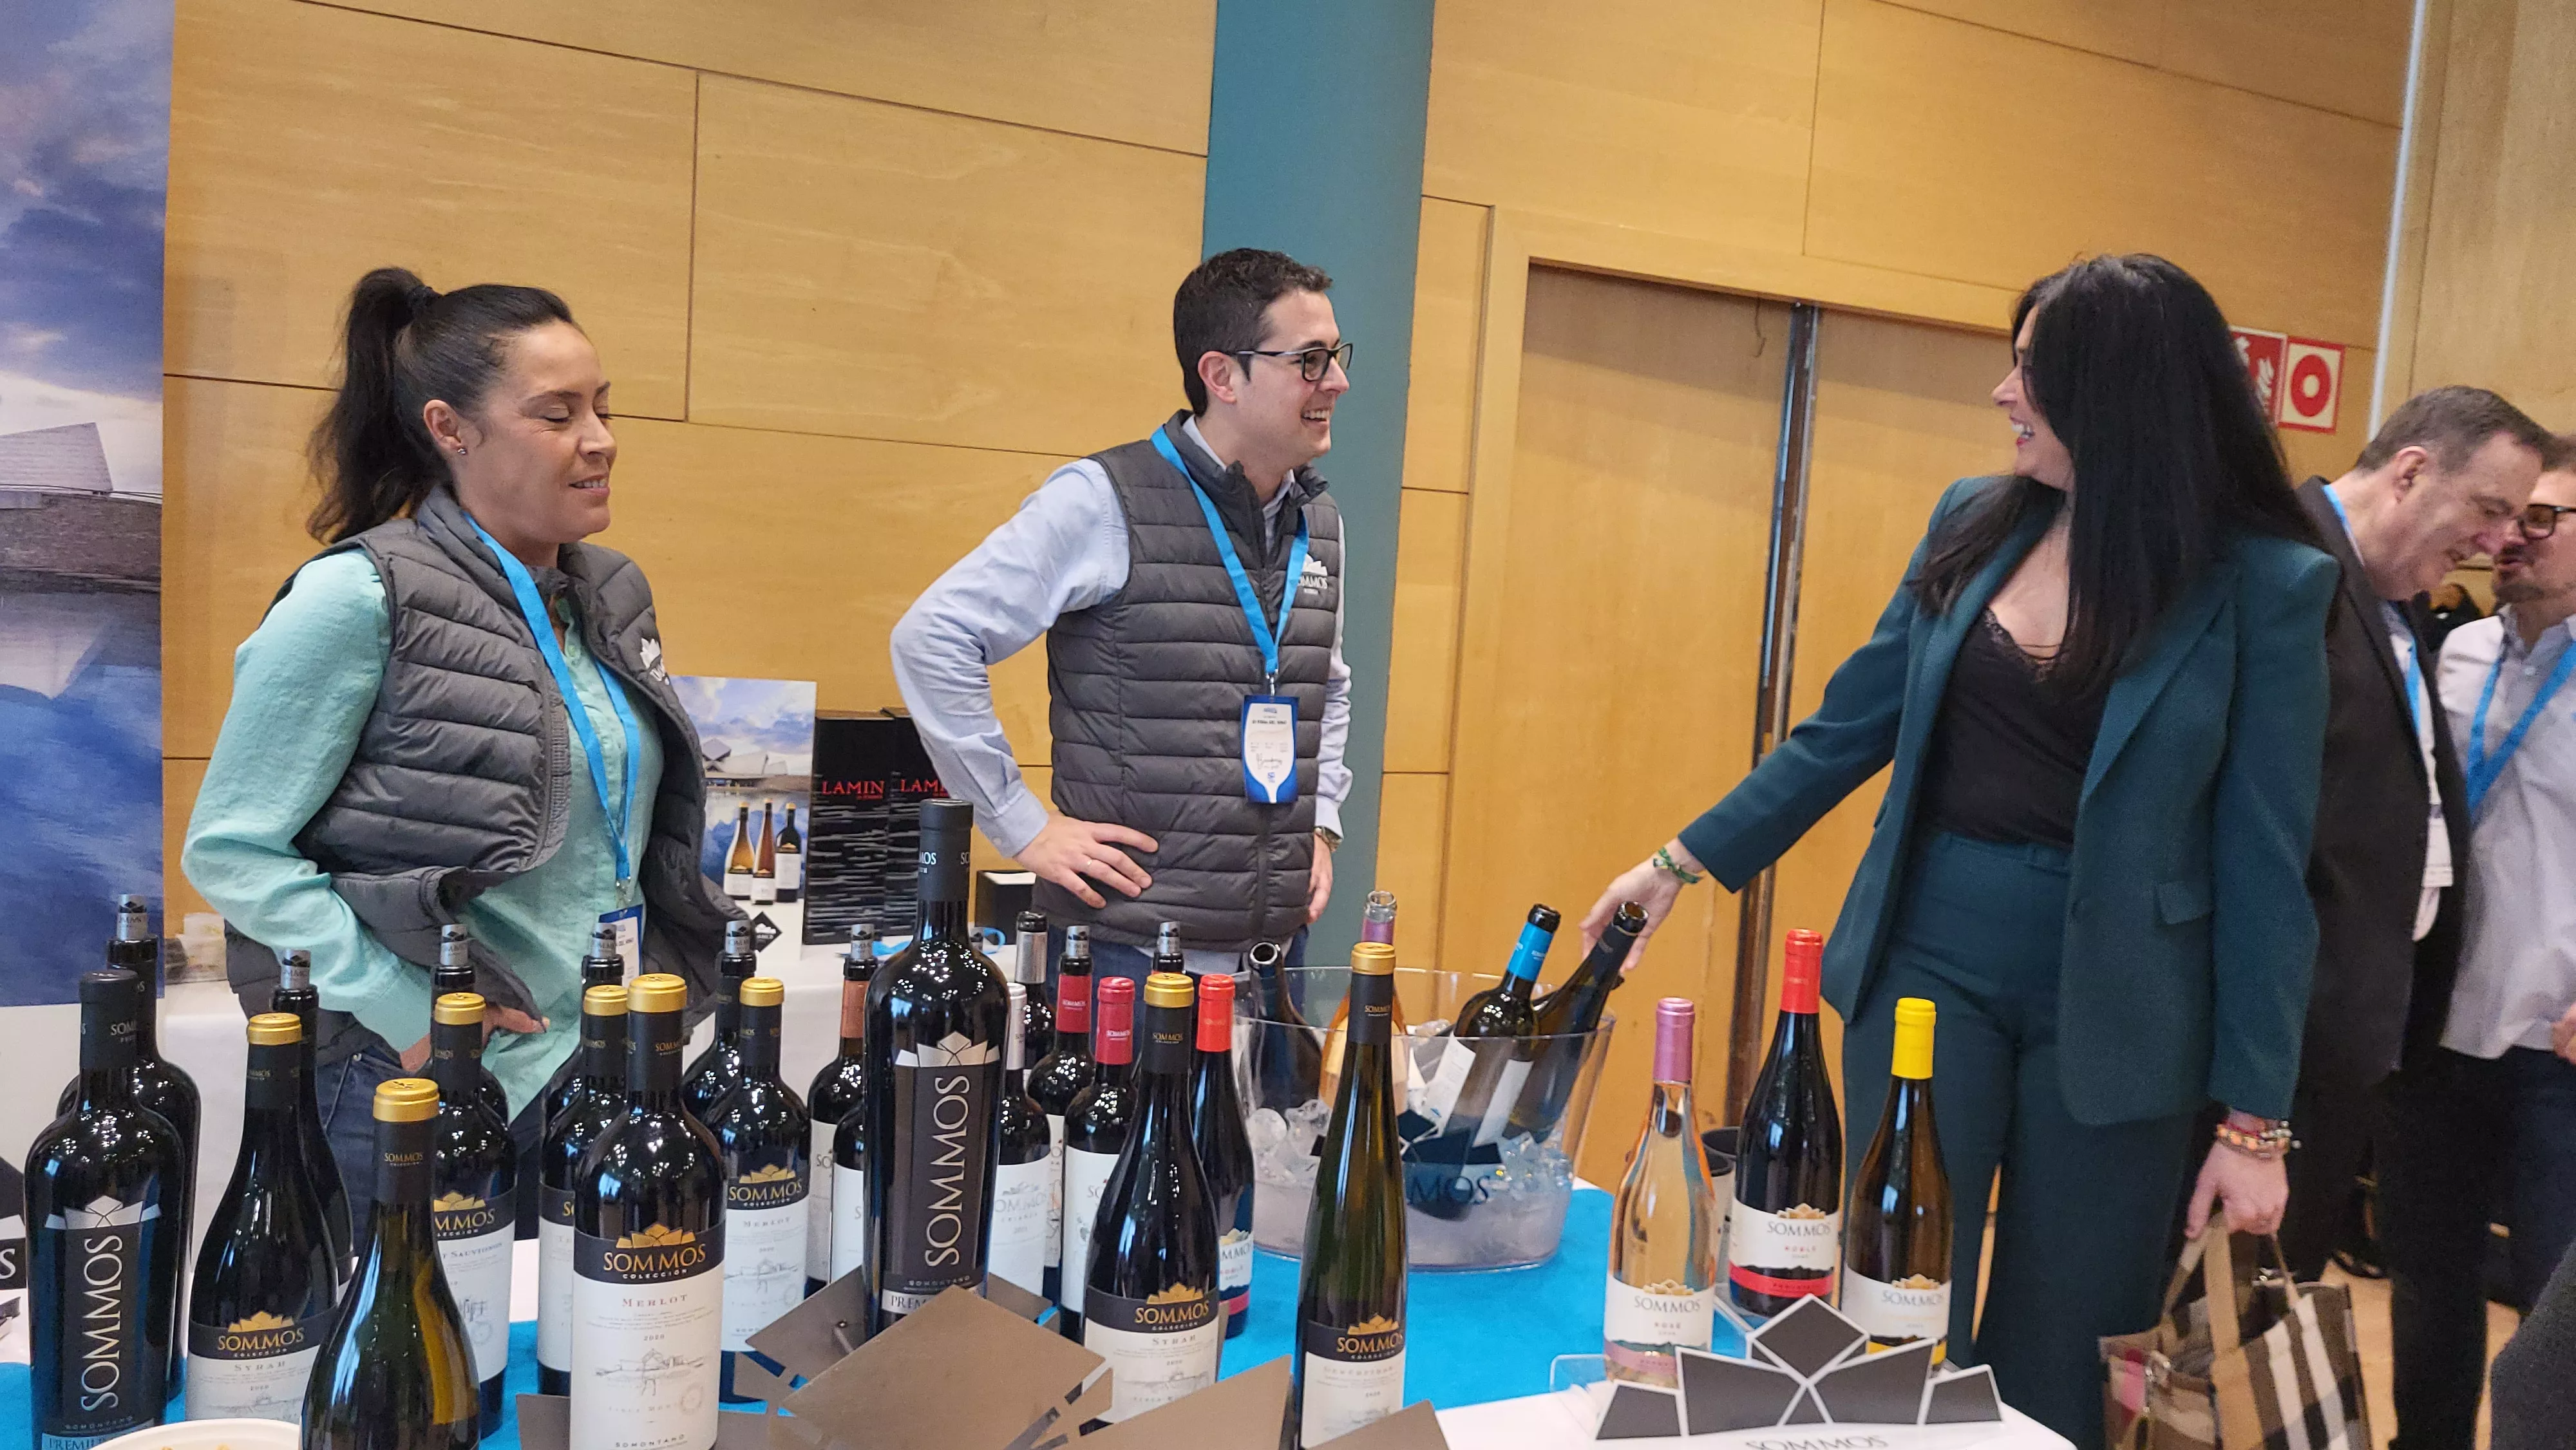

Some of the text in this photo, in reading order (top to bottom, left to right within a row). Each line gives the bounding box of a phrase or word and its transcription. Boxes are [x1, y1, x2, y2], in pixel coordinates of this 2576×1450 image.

[821, 780, 885, 796] LAMIN
[1152, 1032, 1183, 1041] SOMMOS
[384, 1151, 424, 1162] SOMMOS
[924, 1075, 970, 1267] SOMMOS
[728, 1178, 803, 1202] SOMMOS
[1766, 1221, 1833, 1237] SOMMOS
[603, 1243, 706, 1272] SOMMOS
[621, 1294, 688, 1308] MERLOT
[1634, 1295, 1701, 1313] SOMMOS
[1134, 1300, 1209, 1324] SOMMOS
[80, 1235, 123, 1411] SOMMOS
[218, 1326, 305, 1351] SOMMOS
[1336, 1332, 1404, 1354] SOMMOS
[234, 1361, 286, 1372] SYRAH
